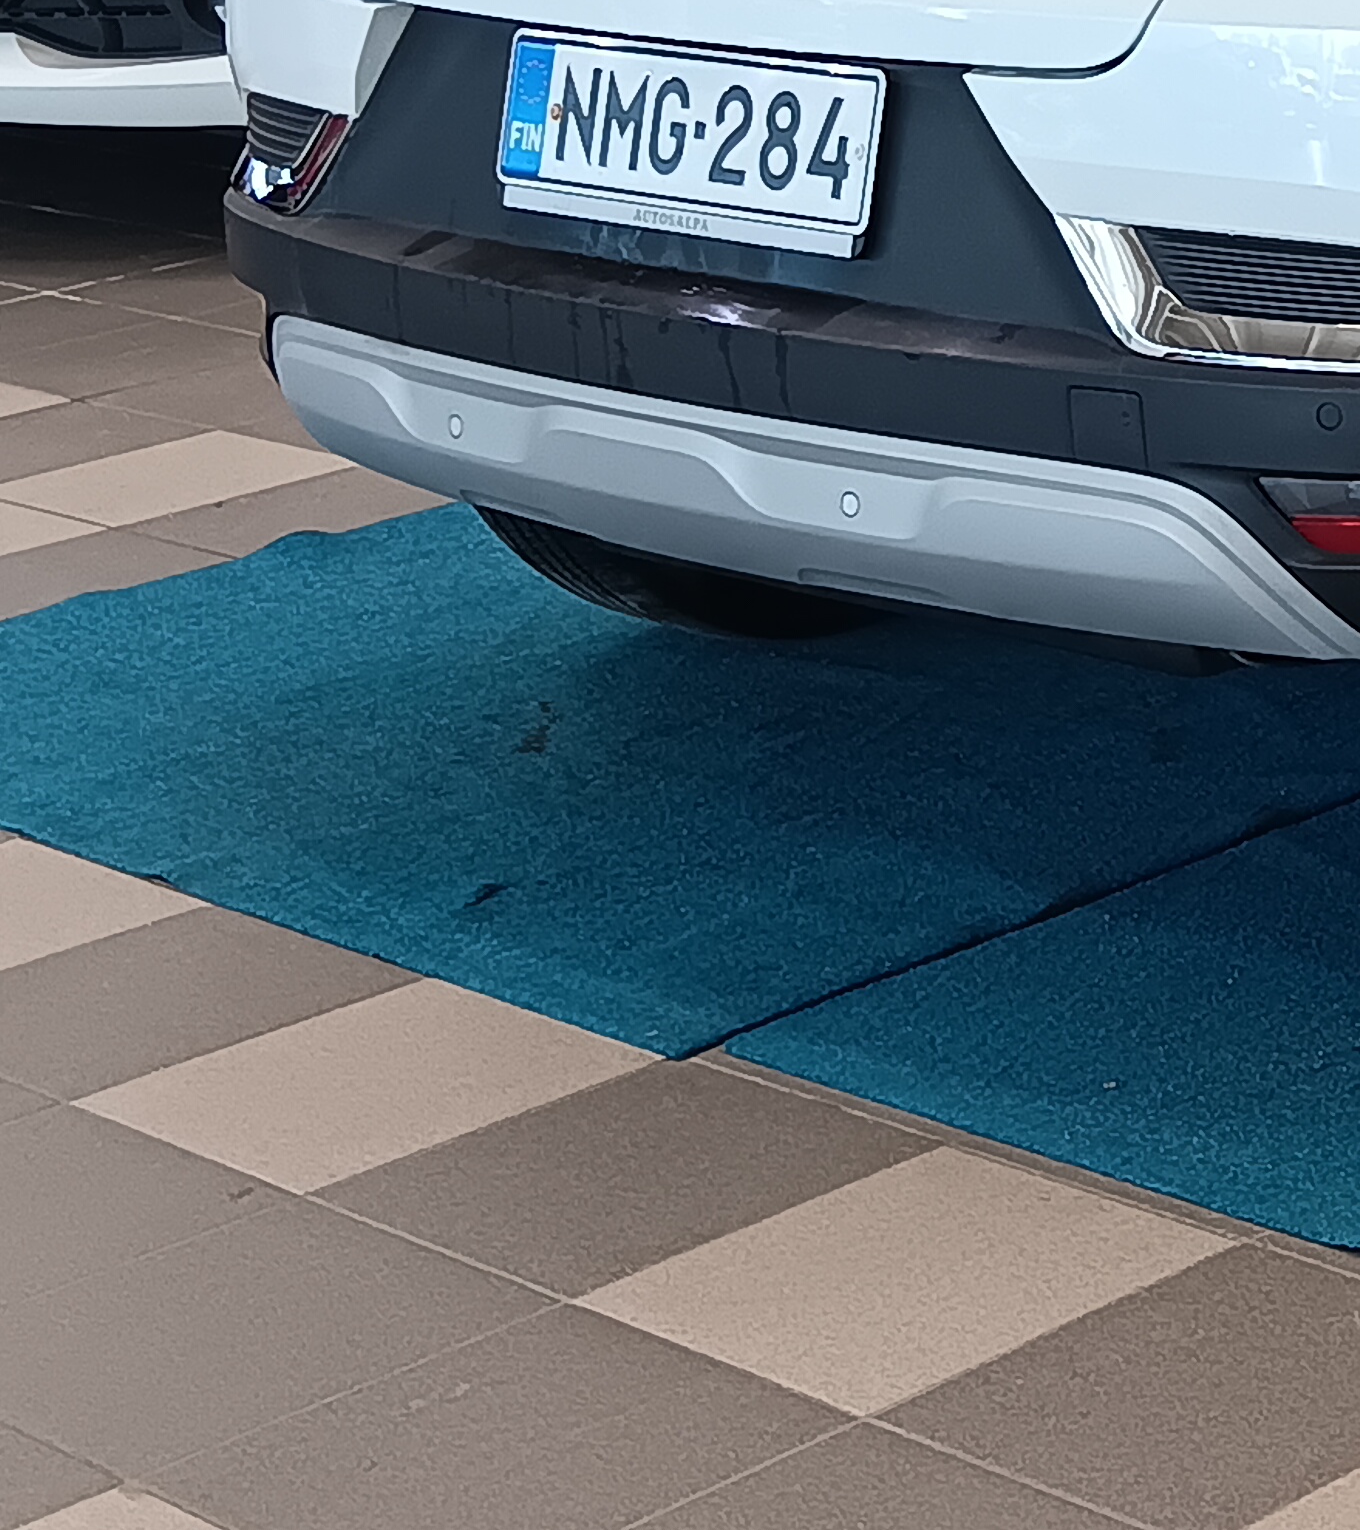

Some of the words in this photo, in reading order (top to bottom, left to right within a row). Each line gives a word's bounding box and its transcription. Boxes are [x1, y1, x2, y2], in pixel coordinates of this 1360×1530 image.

[508, 120, 543, 153] FIN
[554, 62, 851, 200] NMG-284
[632, 208, 709, 232] AUTOSALPA
